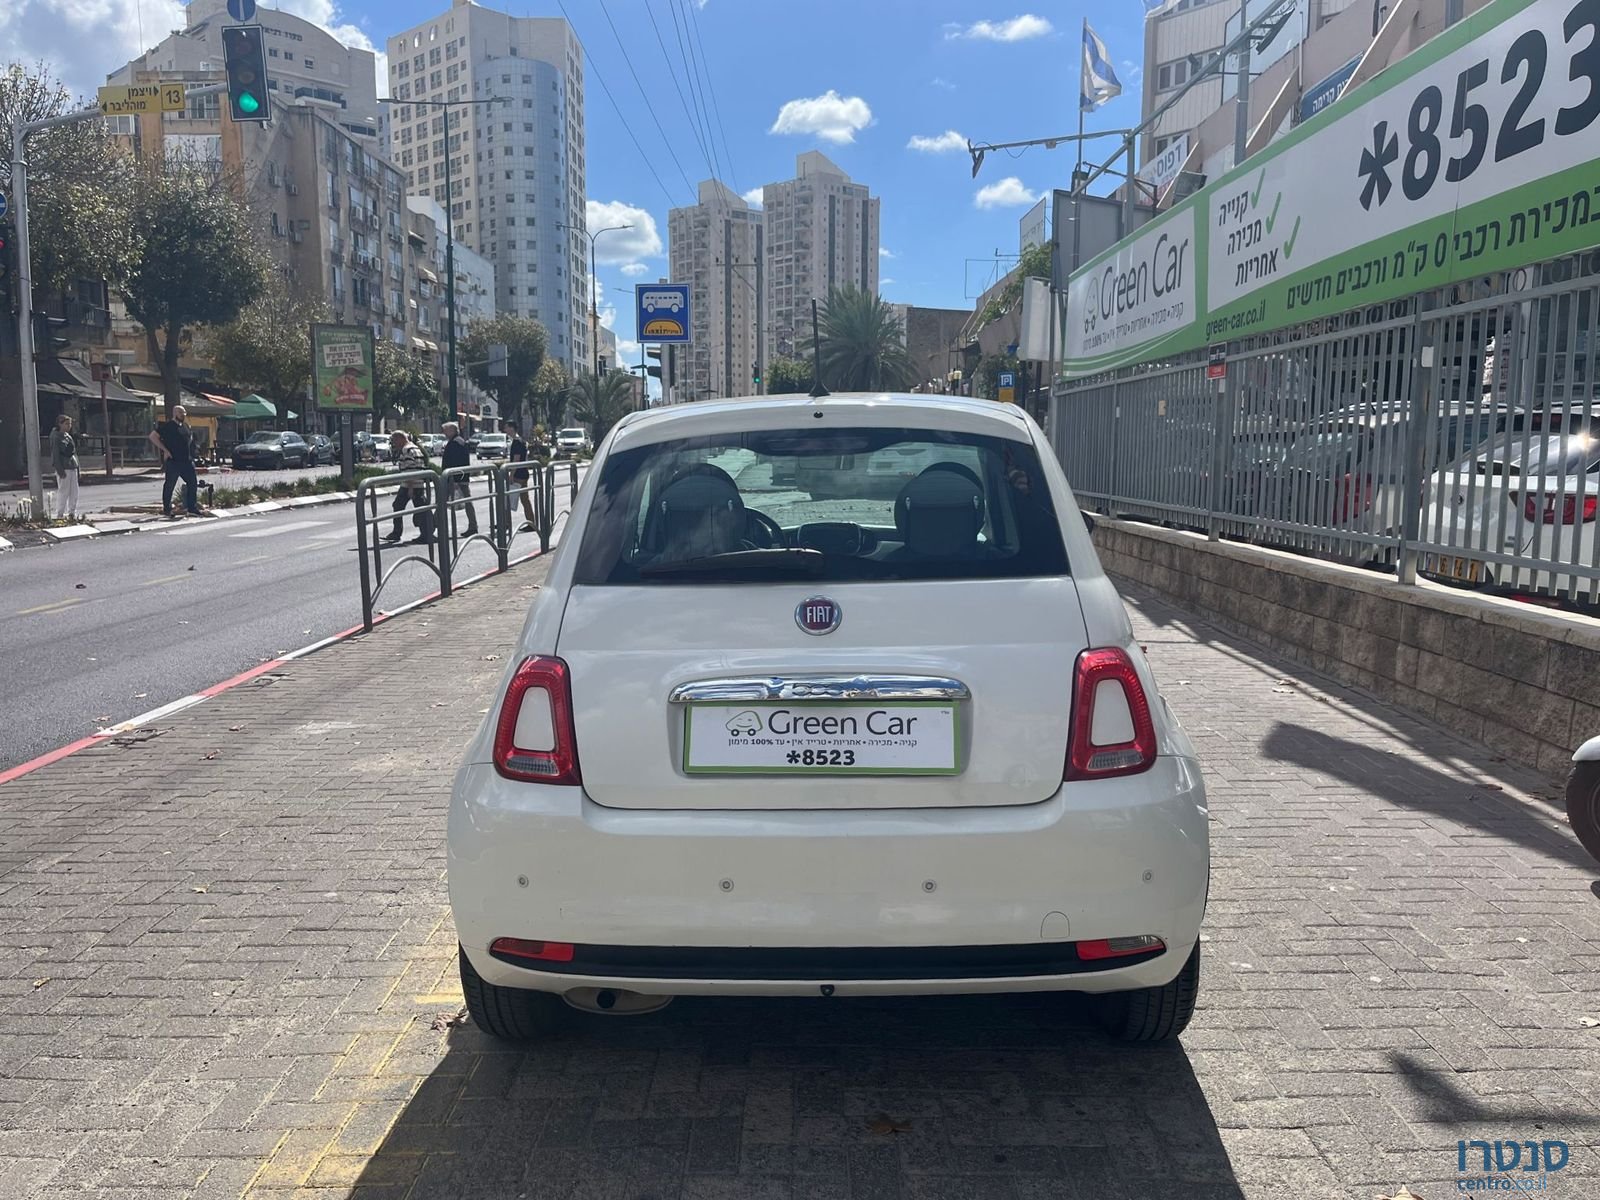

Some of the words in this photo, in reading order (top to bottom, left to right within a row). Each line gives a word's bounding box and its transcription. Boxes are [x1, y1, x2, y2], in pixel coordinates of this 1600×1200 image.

[110, 98, 146, 111] מוהליבר
[128, 87, 152, 100] ויצמן
[166, 90, 181, 104] 13
[1156, 144, 1182, 178] דפוס
[1218, 190, 1249, 226] קנייה
[1227, 218, 1262, 256] מכירה
[1434, 232, 1448, 268] 0
[1452, 219, 1501, 262] רכבי
[1101, 261, 1148, 320] Green
[1152, 233, 1189, 298] Car
[1235, 248, 1279, 287] אחריות
[1336, 258, 1387, 296] ורכבים
[1286, 276, 1332, 310] חדשים
[1206, 298, 1266, 341] green-car.co.il
[806, 606, 832, 624] FIAT
[768, 710, 858, 736] Green
[866, 710, 918, 736] Car
[728, 738, 749, 747] מימון
[775, 738, 785, 746] עד
[791, 738, 804, 746] אין
[806, 738, 827, 746] טרייד
[833, 738, 862, 746] אחריות
[898, 739, 918, 748] קניה
